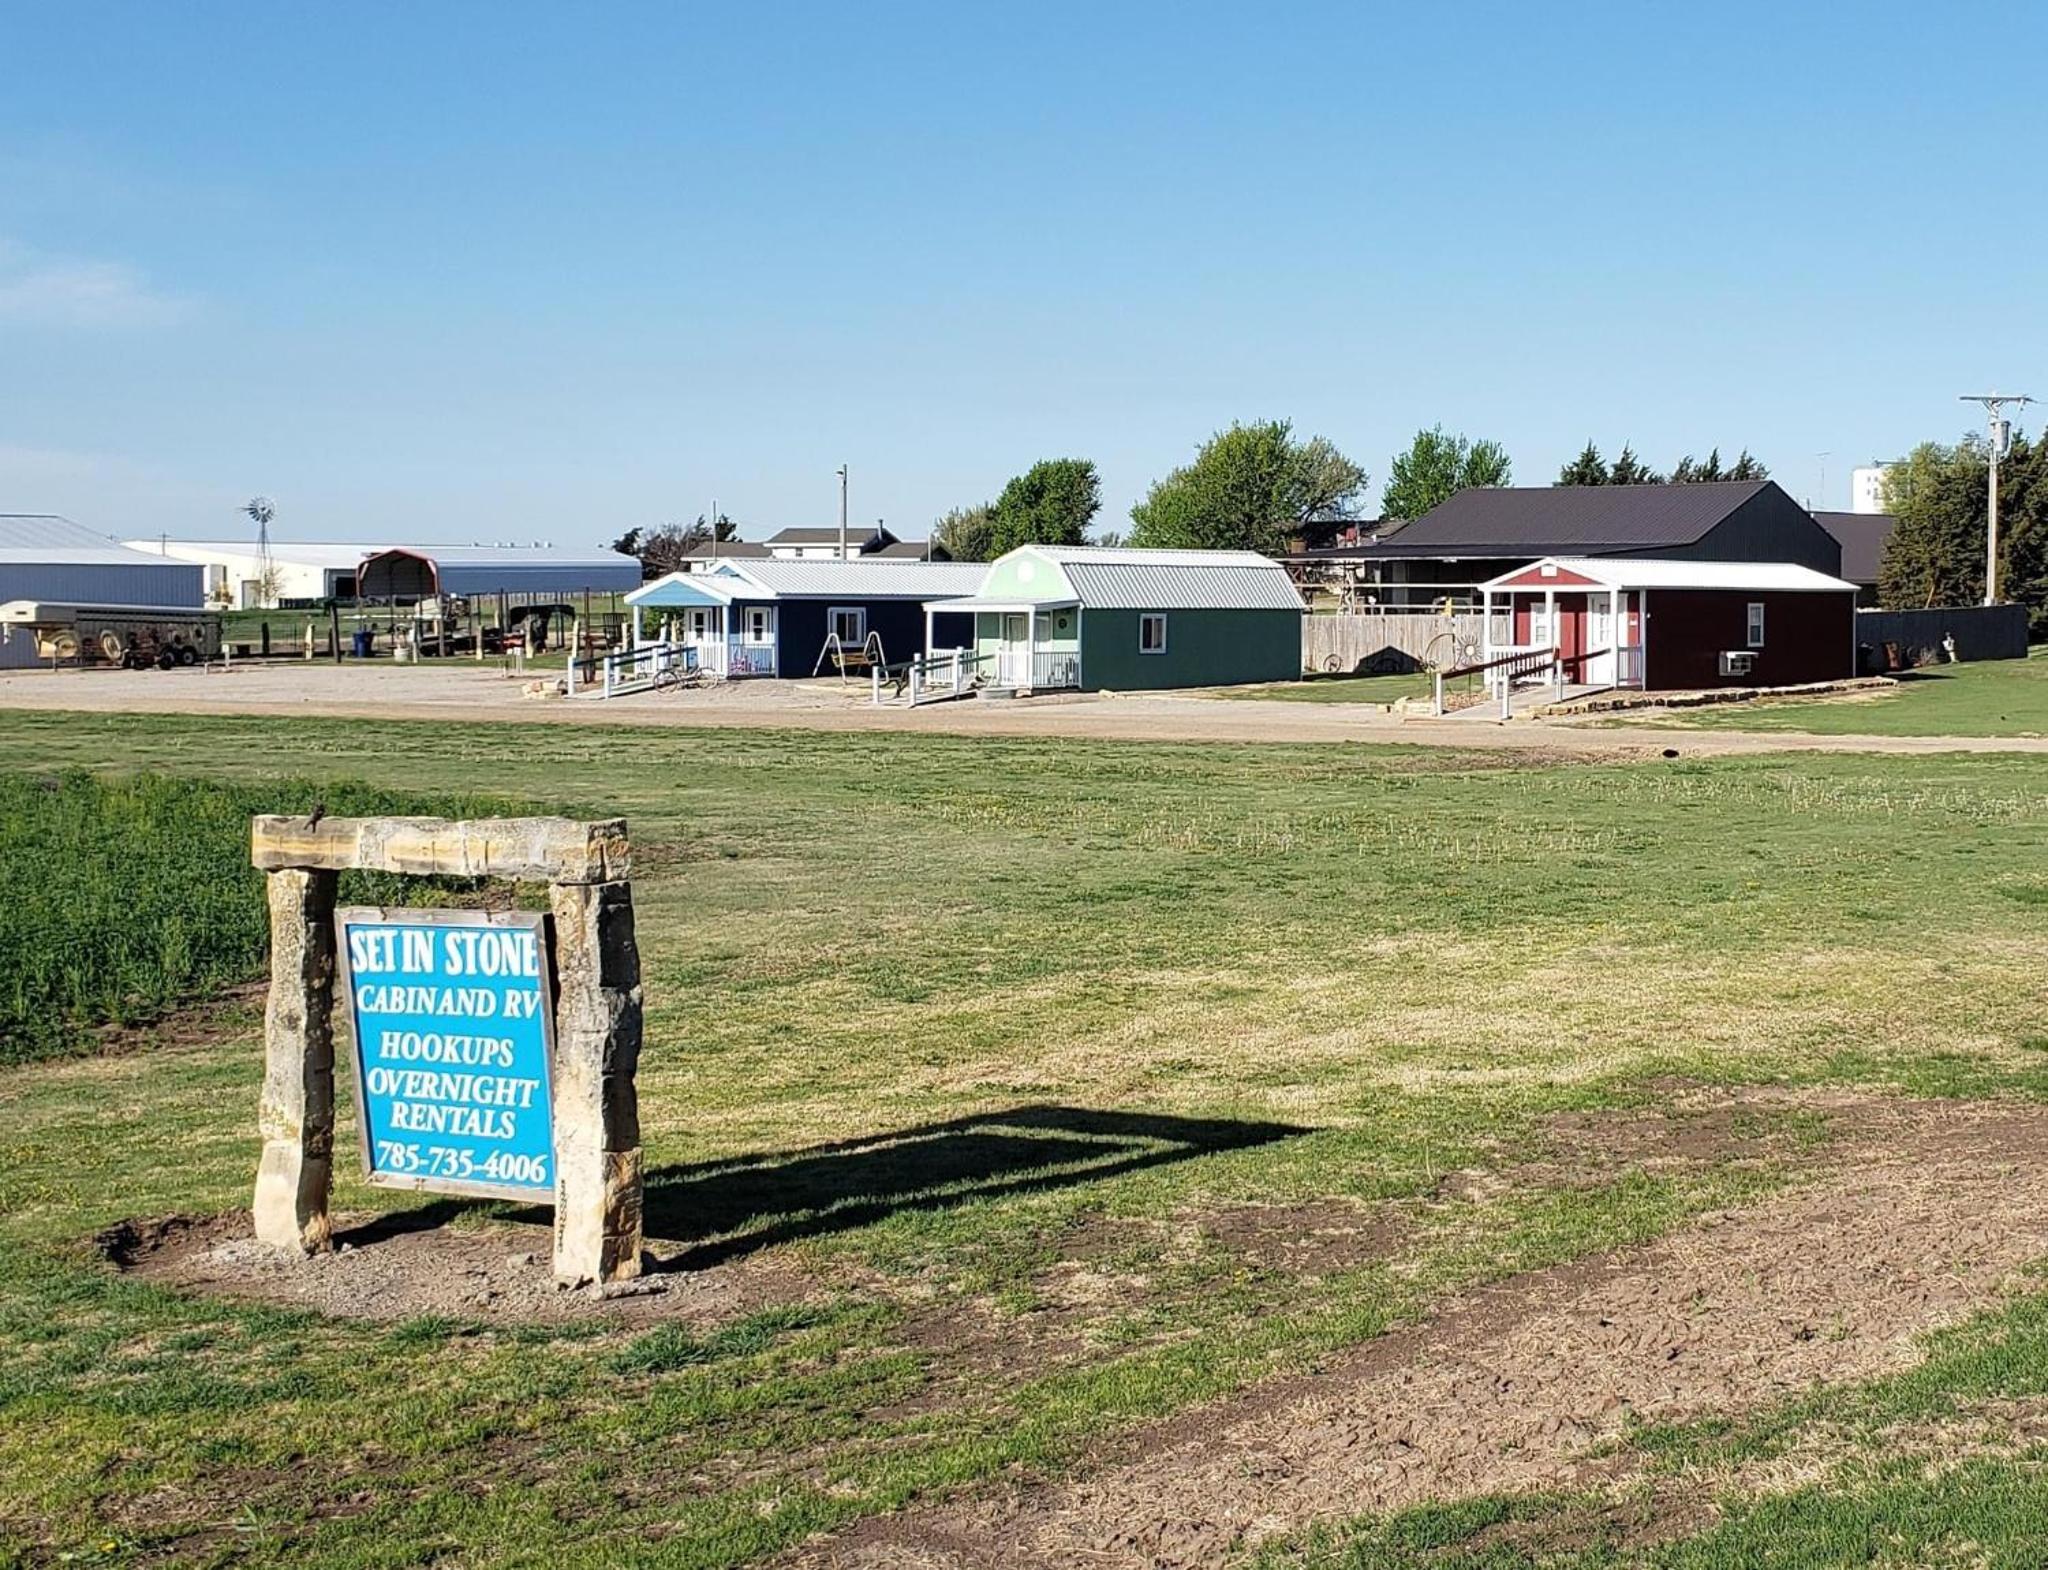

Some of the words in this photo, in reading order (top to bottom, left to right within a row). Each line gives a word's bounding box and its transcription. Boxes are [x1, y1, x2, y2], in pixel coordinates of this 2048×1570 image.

[350, 929, 398, 973] SET
[402, 930, 436, 973] IN
[444, 932, 540, 977] STONE
[357, 984, 438, 1015] CABIN
[440, 988, 496, 1017] AND
[502, 990, 542, 1018] RV
[379, 1031, 514, 1067] HOOKUPS
[367, 1068, 540, 1108] OVERNIGHT
[390, 1102, 516, 1139] RENTALS
[377, 1141, 548, 1182] 785-735-4006
